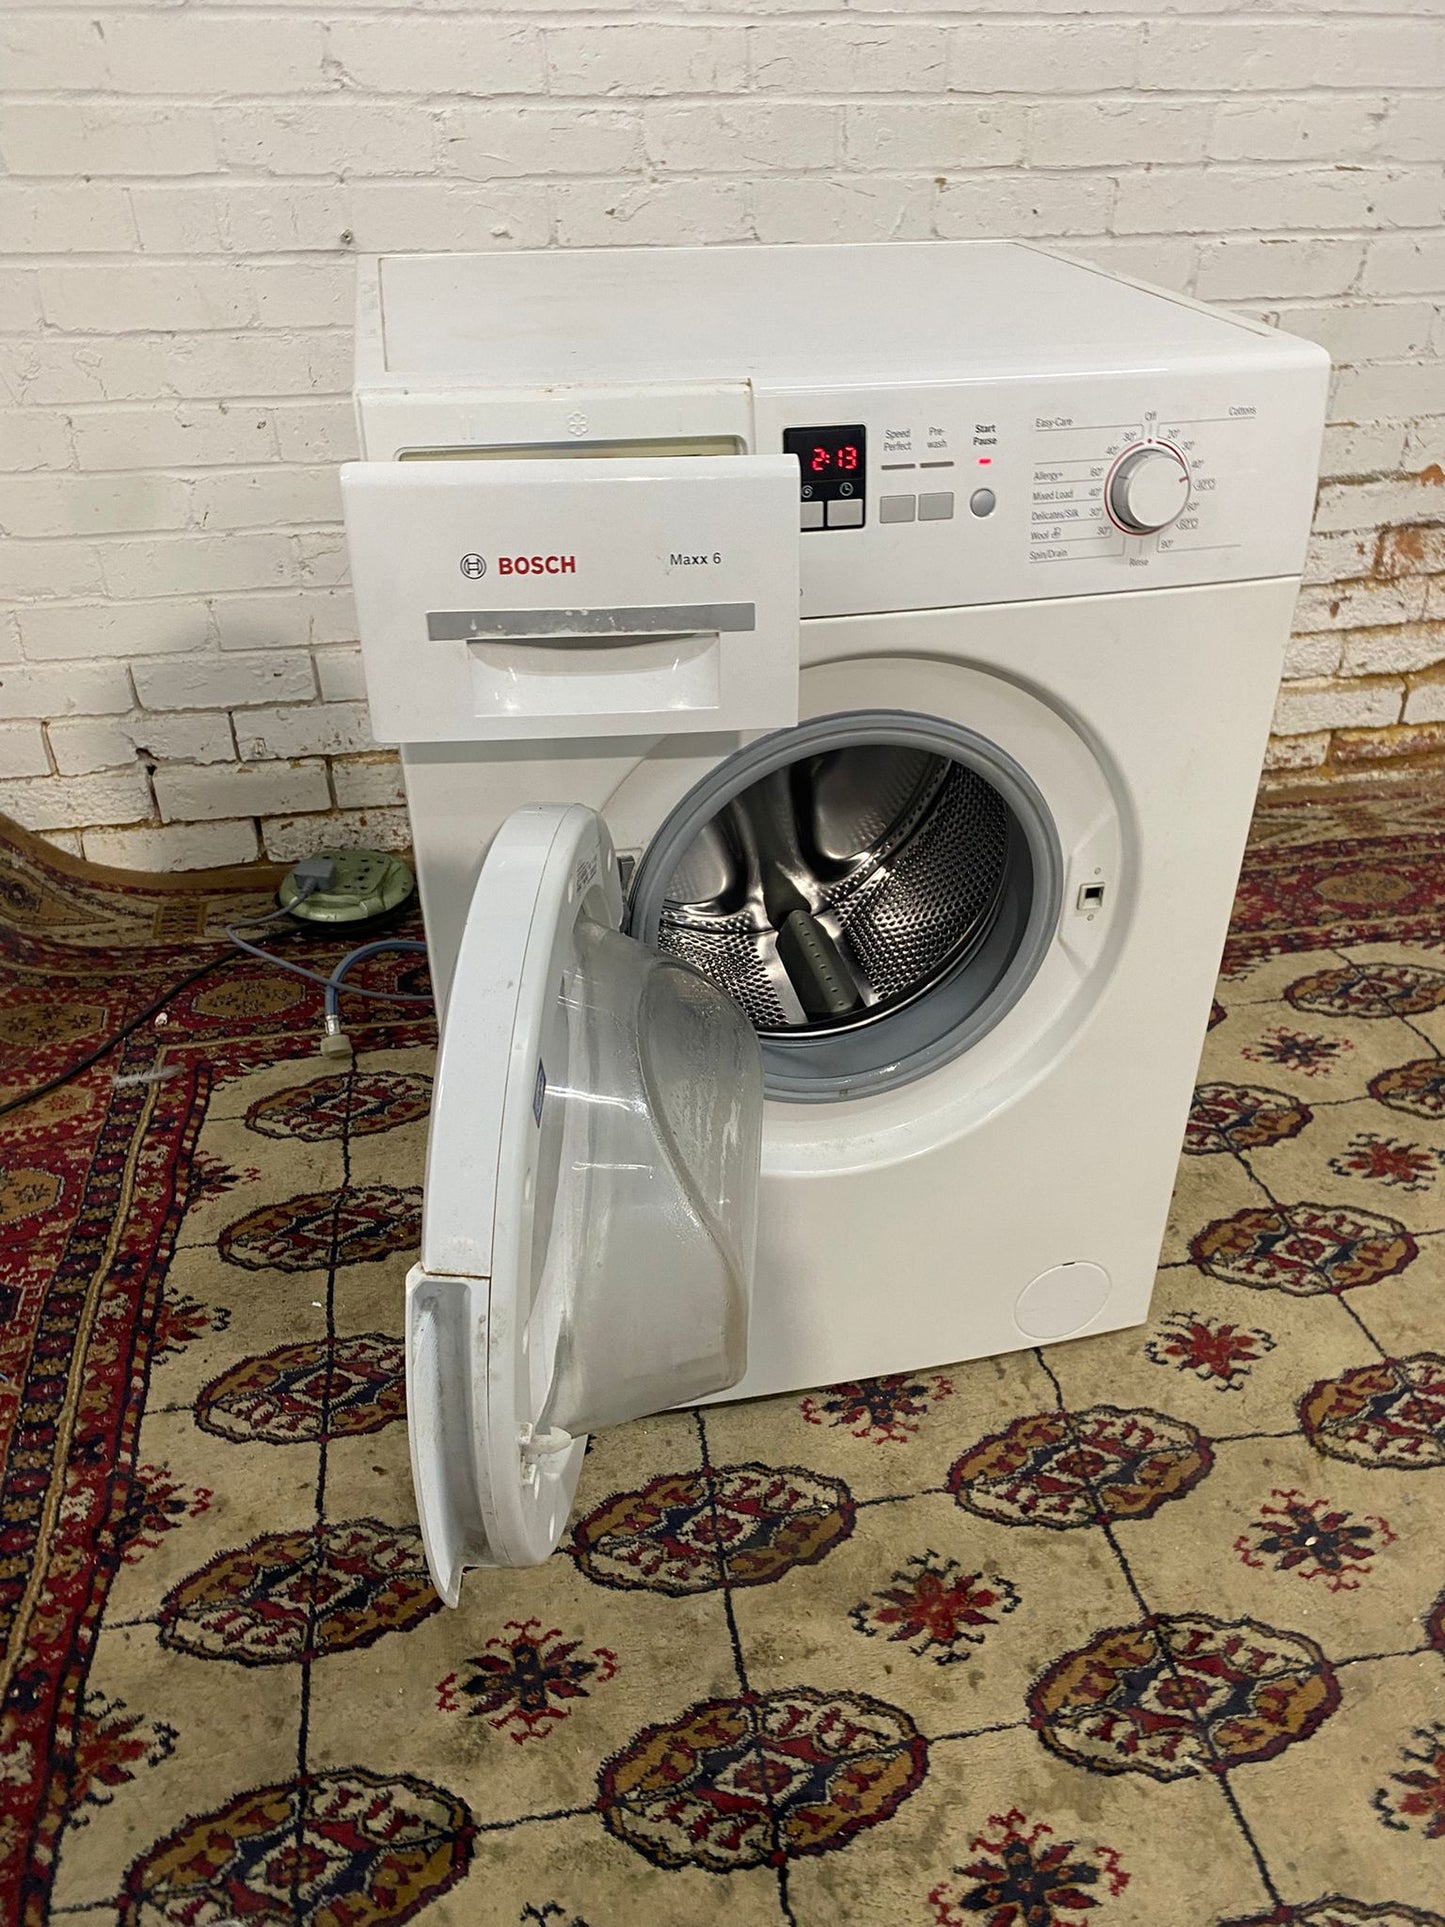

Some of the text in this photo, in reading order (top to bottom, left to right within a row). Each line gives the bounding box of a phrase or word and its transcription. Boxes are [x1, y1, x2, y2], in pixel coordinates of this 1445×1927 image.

[1228, 406, 1257, 416] Cottons
[885, 428, 911, 440] Speed
[975, 424, 996, 434] Start
[884, 441, 912, 452] Perfect
[927, 439, 947, 449] wash
[973, 436, 997, 446] Pause
[1032, 491, 1055, 501] Mixed
[1055, 489, 1074, 500] Load
[1030, 530, 1050, 540] Wool
[669, 552, 722, 566] Maxx 6
[1029, 549, 1068, 560] Spin/Drain
[498, 556, 576, 575] BOSCH
